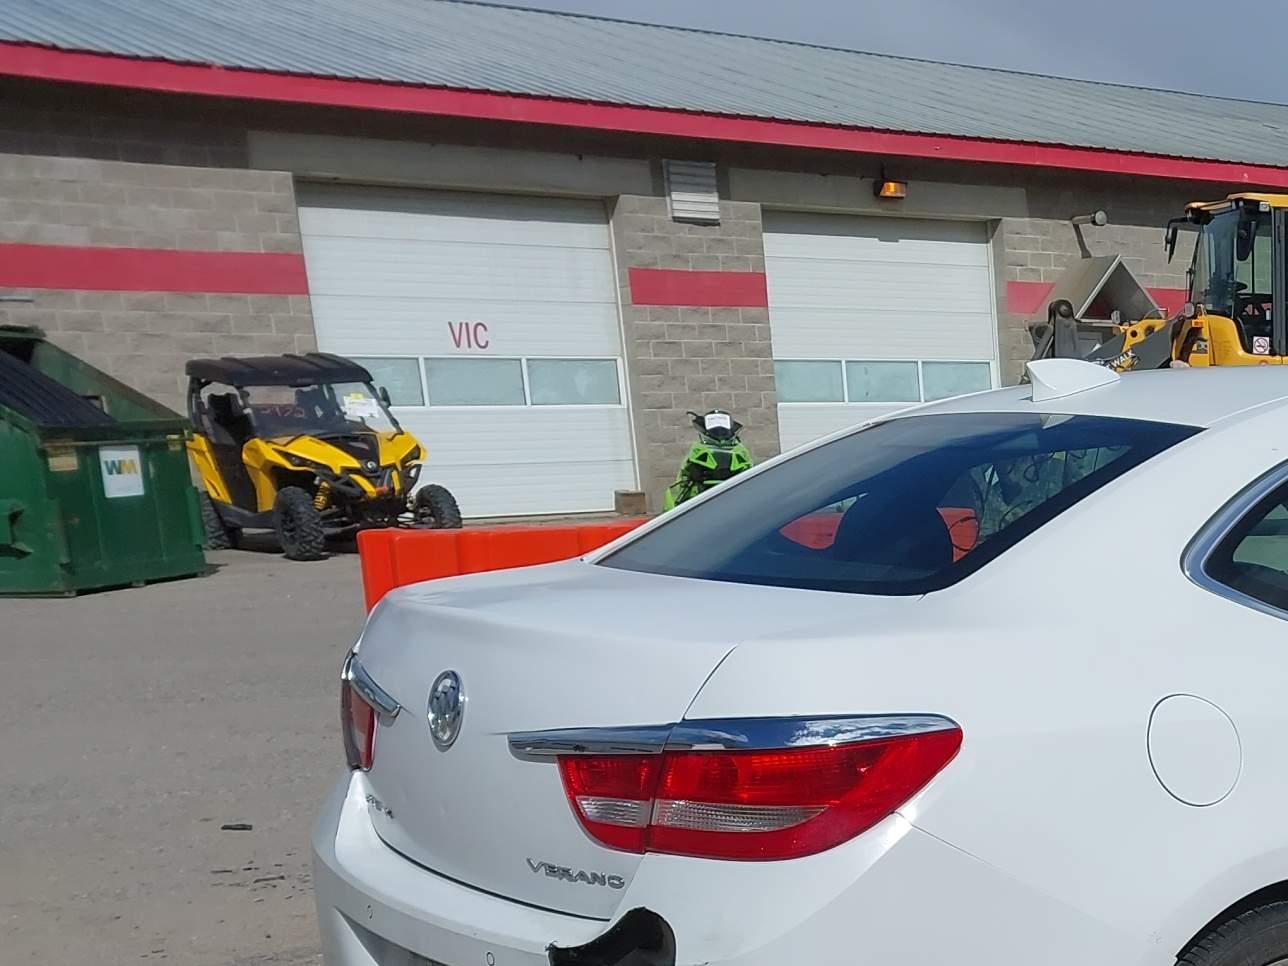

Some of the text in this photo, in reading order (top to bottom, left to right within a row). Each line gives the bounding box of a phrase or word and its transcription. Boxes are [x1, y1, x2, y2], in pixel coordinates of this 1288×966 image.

[447, 321, 489, 349] VIC
[104, 459, 138, 475] WM
[526, 857, 625, 889] VERANO
